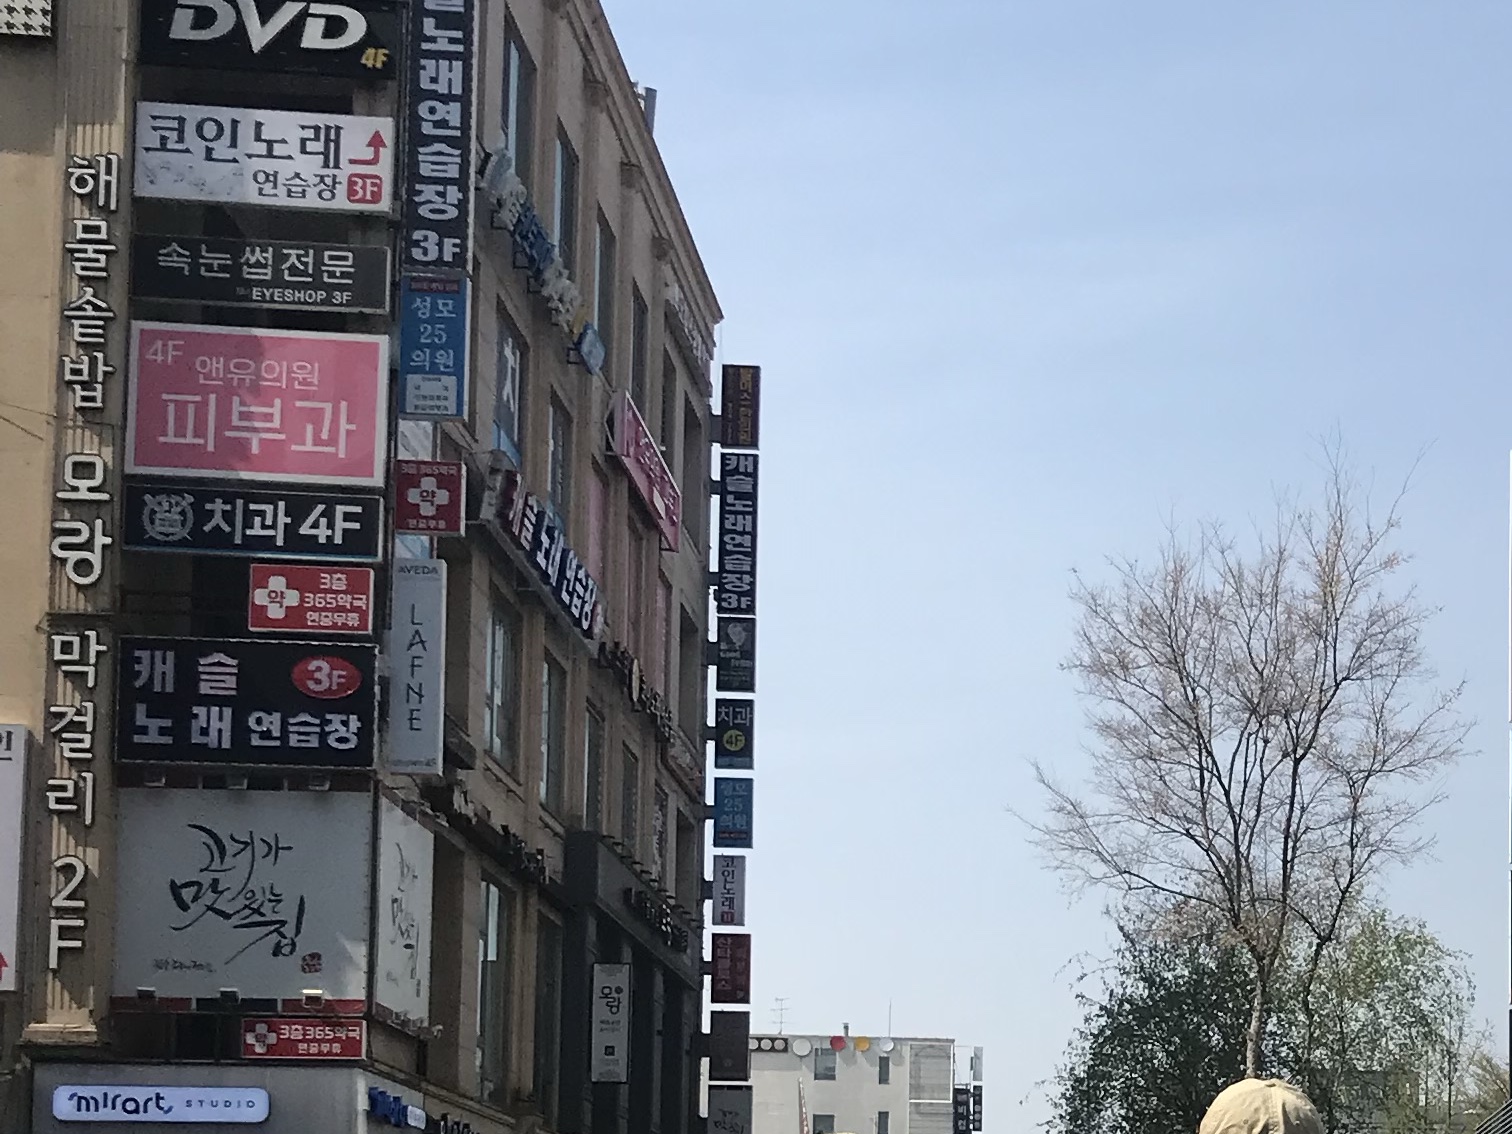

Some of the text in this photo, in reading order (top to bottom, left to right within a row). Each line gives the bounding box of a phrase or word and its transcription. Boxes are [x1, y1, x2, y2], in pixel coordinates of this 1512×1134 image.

[168, 0, 368, 53] DVD
[360, 47, 390, 68] 4F
[414, 17, 466, 222] 노래연습장
[142, 113, 345, 170] 코인노래
[252, 168, 381, 202] 연습장 3F
[411, 230, 461, 262] 3F
[157, 242, 356, 284] 속눈썹전문
[252, 286, 327, 305] EYESHOP
[331, 291, 353, 304] 3F
[419, 323, 447, 344] 25
[145, 340, 321, 391] 4F 앤유의원
[409, 348, 455, 372] 의원
[158, 392, 357, 459] 피부과
[202, 498, 364, 547] 치과 4F
[46, 153, 121, 970] 해물솥밥 오랑 막걸리 2F
[398, 565, 439, 575] AVEDA
[319, 573, 348, 591] 3층
[267, 590, 286, 609] 약
[303, 593, 368, 610] 365약국
[721, 594, 752, 610] 3F
[306, 612, 360, 627] 연중무휴
[133, 649, 347, 697] 캐슬 3F
[133, 703, 361, 751] 노래 연습장
[717, 706, 752, 727] 치과
[68, 1091, 256, 1115] mirart STUDIO
